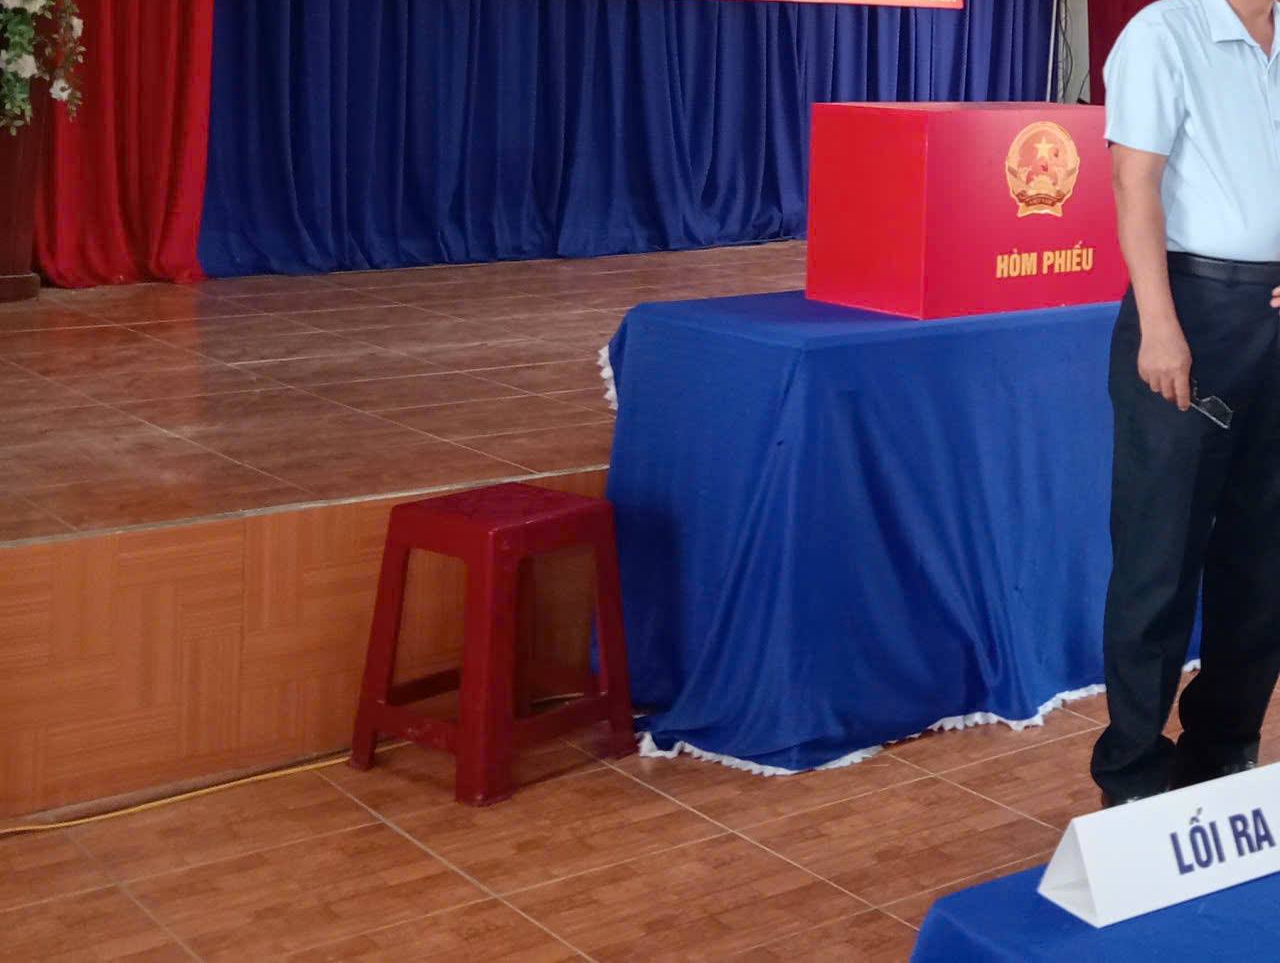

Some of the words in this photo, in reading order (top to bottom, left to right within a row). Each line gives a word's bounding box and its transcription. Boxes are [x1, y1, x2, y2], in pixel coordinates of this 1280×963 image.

[996, 248, 1037, 278] HÒM
[1042, 241, 1094, 274] PHIẾU
[1169, 807, 1226, 876] LỐI
[1228, 807, 1276, 858] RA
